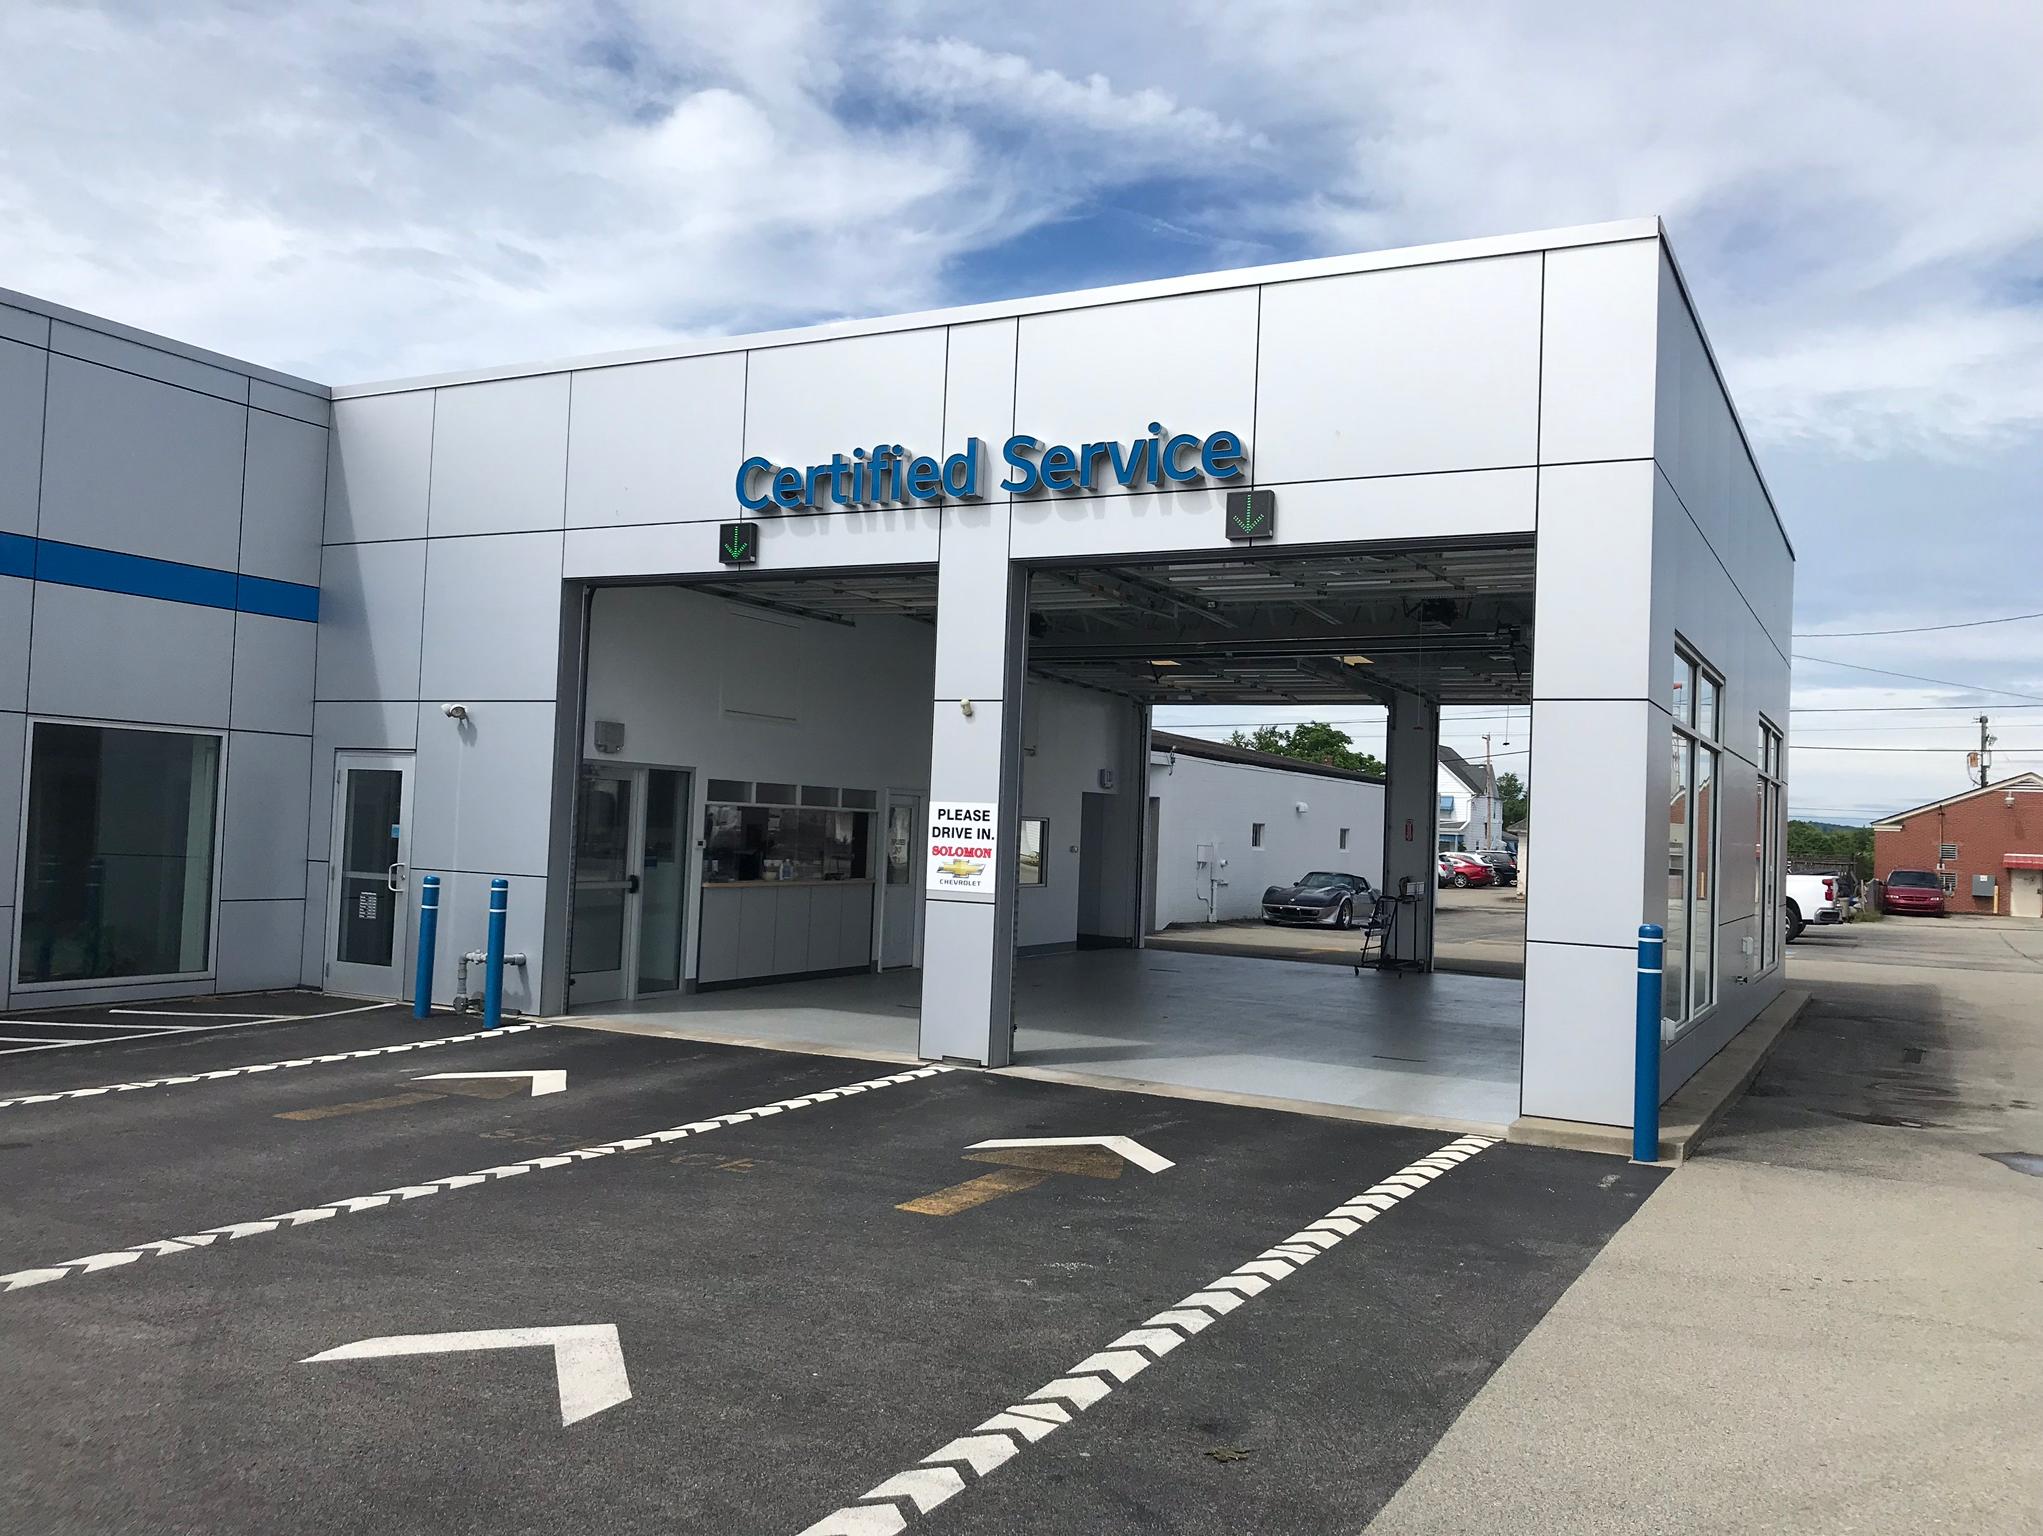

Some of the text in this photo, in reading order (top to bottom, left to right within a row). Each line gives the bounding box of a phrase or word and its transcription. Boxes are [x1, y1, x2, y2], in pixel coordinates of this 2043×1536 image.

[735, 421, 1249, 512] Certified Service
[938, 809, 991, 822] PLEASE
[932, 826, 995, 841] DRIVE IN.
[932, 845, 992, 859] SOLOMON
[939, 878, 982, 887] CHEVROLET
